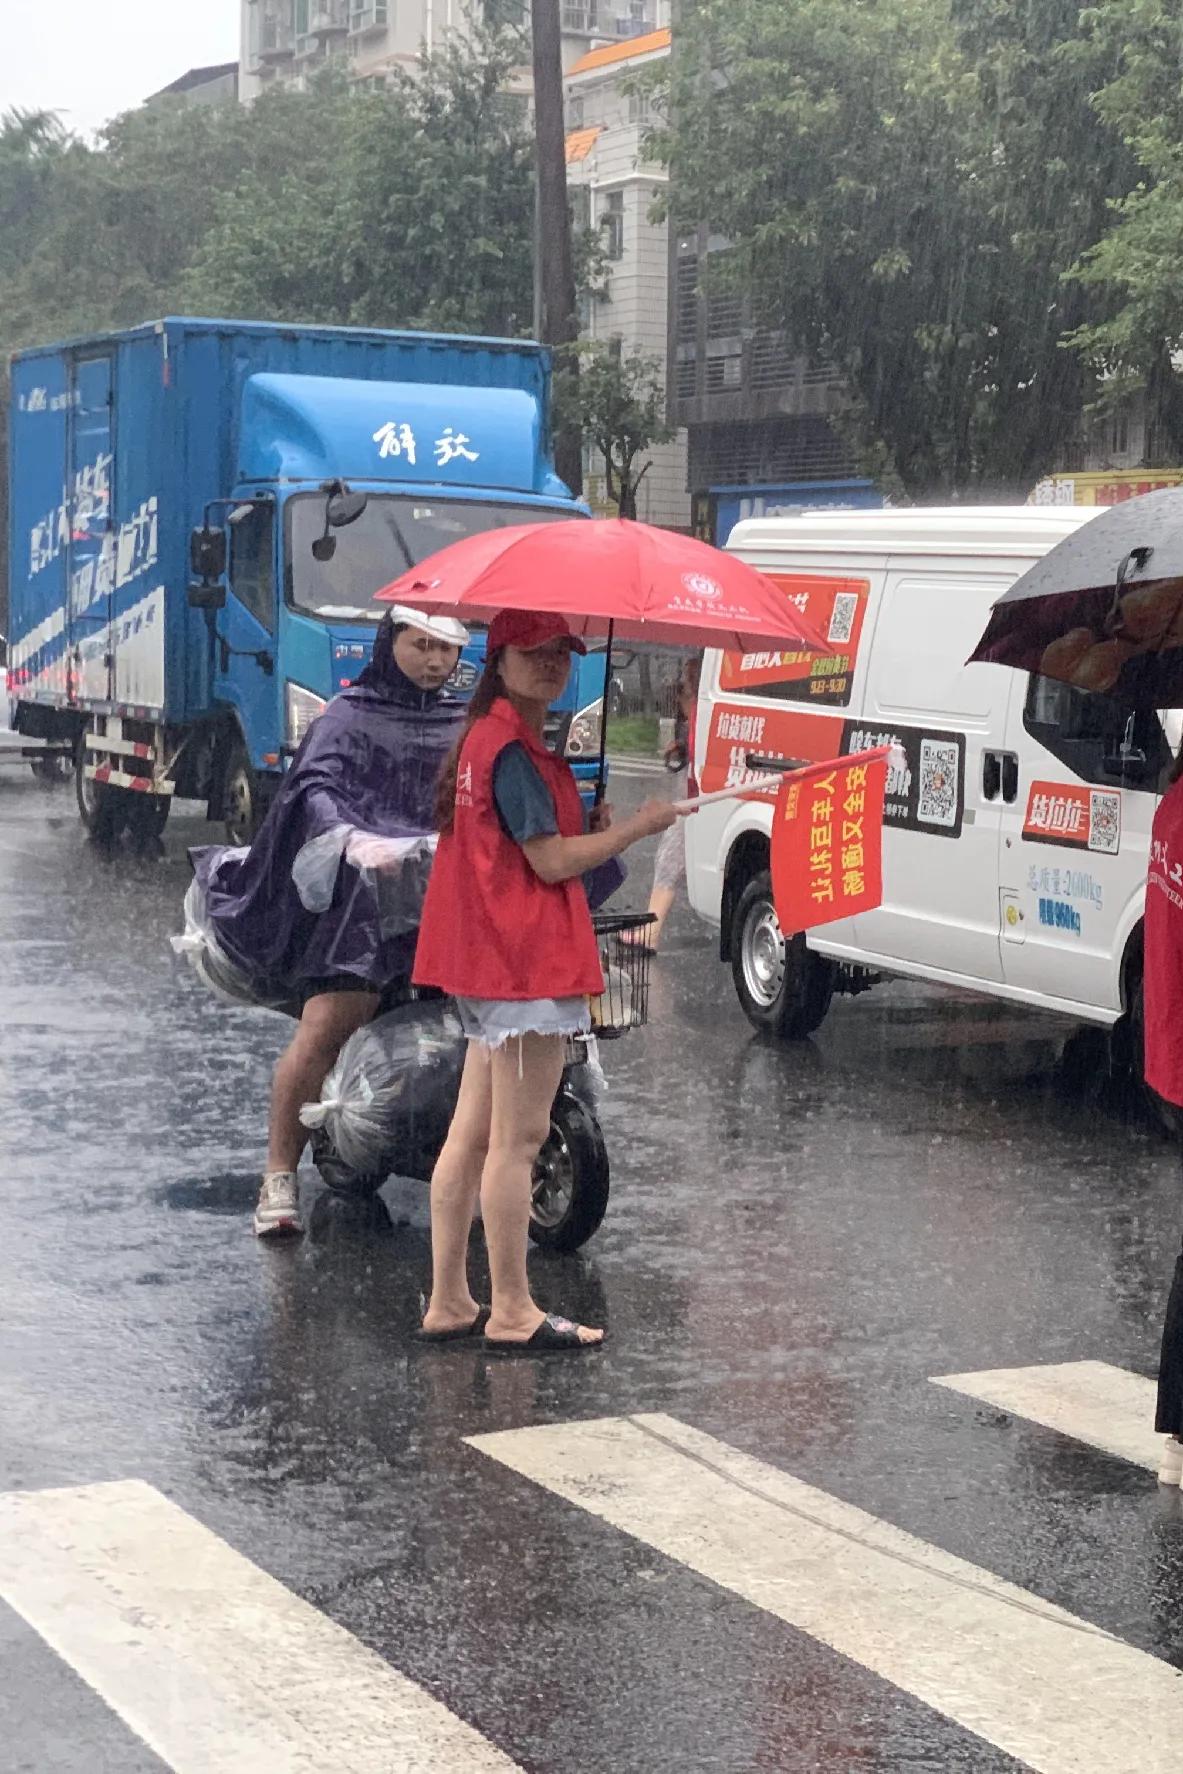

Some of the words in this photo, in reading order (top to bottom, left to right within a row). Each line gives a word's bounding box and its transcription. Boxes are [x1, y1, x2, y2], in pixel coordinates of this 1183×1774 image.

[372, 421, 480, 466] 解放
[1027, 793, 1089, 835] 货拉拉
